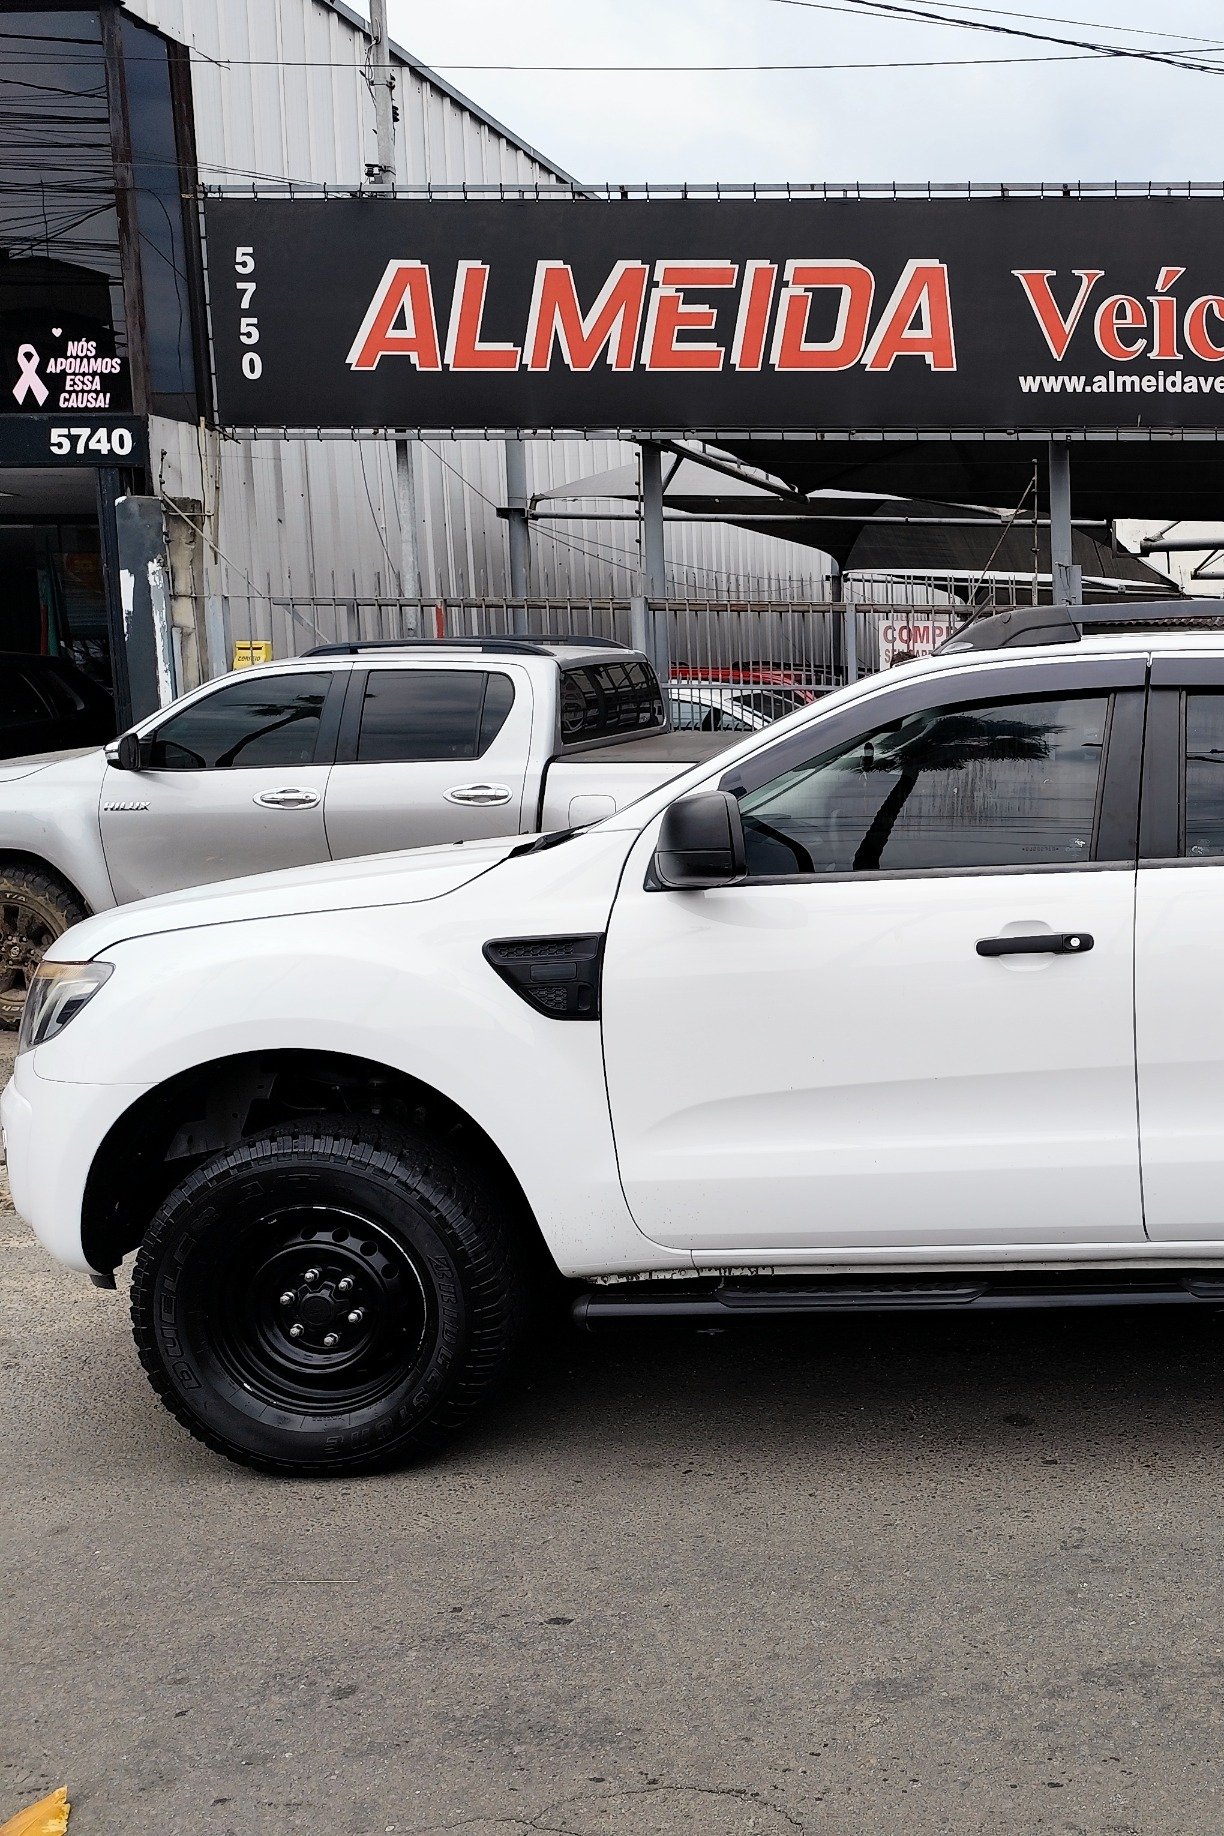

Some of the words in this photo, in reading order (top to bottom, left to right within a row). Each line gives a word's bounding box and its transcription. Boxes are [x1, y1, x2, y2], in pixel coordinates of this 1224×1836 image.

[346, 258, 958, 372] ALMEIDA
[66, 338, 97, 357] NÓS
[46, 357, 122, 373] APOIAMOS
[65, 375, 101, 391] ESSA
[59, 392, 111, 408] CAUSA!
[49, 427, 133, 456] 5740
[103, 801, 151, 811] HILUX
